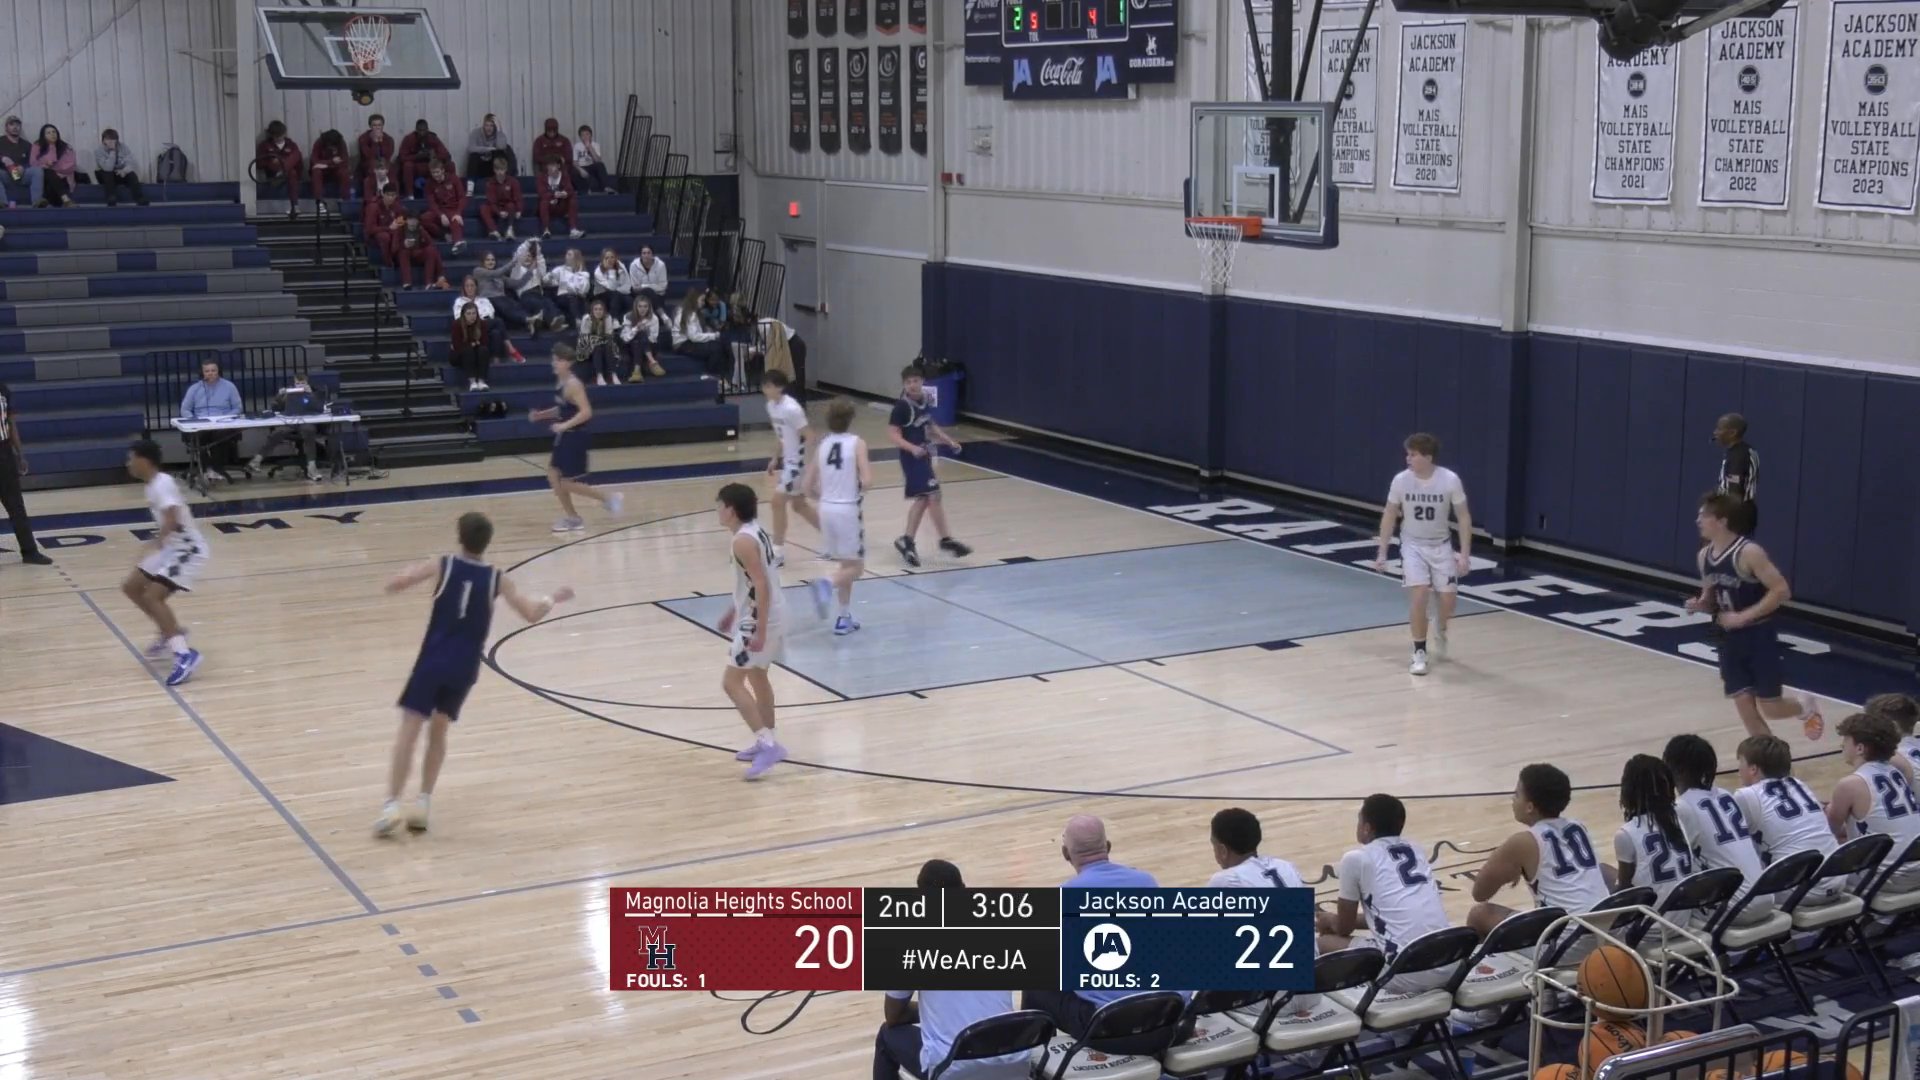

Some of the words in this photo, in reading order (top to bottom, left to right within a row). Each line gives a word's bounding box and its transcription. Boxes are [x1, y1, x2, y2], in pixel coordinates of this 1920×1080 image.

[1013, 6, 1022, 31] 2
[1088, 8, 1097, 26] 4
[1844, 13, 1918, 33] JACKSON
[1721, 19, 1784, 39] JACKSON
[1410, 33, 1456, 50] JACKSON
[1842, 38, 1918, 59] ACADEMY
[1719, 41, 1785, 61] ACADEMY
[1409, 56, 1456, 72] ACADEMY
[1418, 109, 1440, 121] MAIS
[1623, 104, 1648, 119] MAIS
[1733, 99, 1762, 115] MAIS
[1858, 101, 1889, 117] MAIS
[1402, 123, 1457, 137] VOLLEYBALL
[1600, 121, 1671, 136] VOLLEYBALL
[1711, 118, 1786, 135] VOLLEYBALL
[1831, 119, 1916, 138] VOLLEYBALL
[1336, 135, 1359, 147] STATE
[1415, 138, 1441, 152] STATE
[1618, 139, 1652, 154] STATE
[1728, 138, 1764, 154] STATE
[1850, 140, 1889, 156] STATE
[1405, 152, 1453, 167] CHAMPIONS
[1605, 156, 1665, 172] CHAMPIONS
[1714, 157, 1779, 174] CHAMPIONS
[1834, 158, 1909, 177] CHAMPIONS
[1415, 168, 1437, 181] 2020
[1621, 174, 1645, 189] 2021
[1729, 176, 1757, 191] 2022
[1852, 178, 1884, 194] 2023
[826, 442, 843, 470] 4
[1405, 493, 1444, 503] RAIDERS
[1414, 505, 1435, 521] 20
[456, 580, 472, 619] 1
[1762, 776, 1822, 821] 31
[1699, 792, 1751, 846] 12
[1541, 823, 1597, 878] 10
[1387, 842, 1428, 888] 2
[1263, 868, 1288, 887] 1
